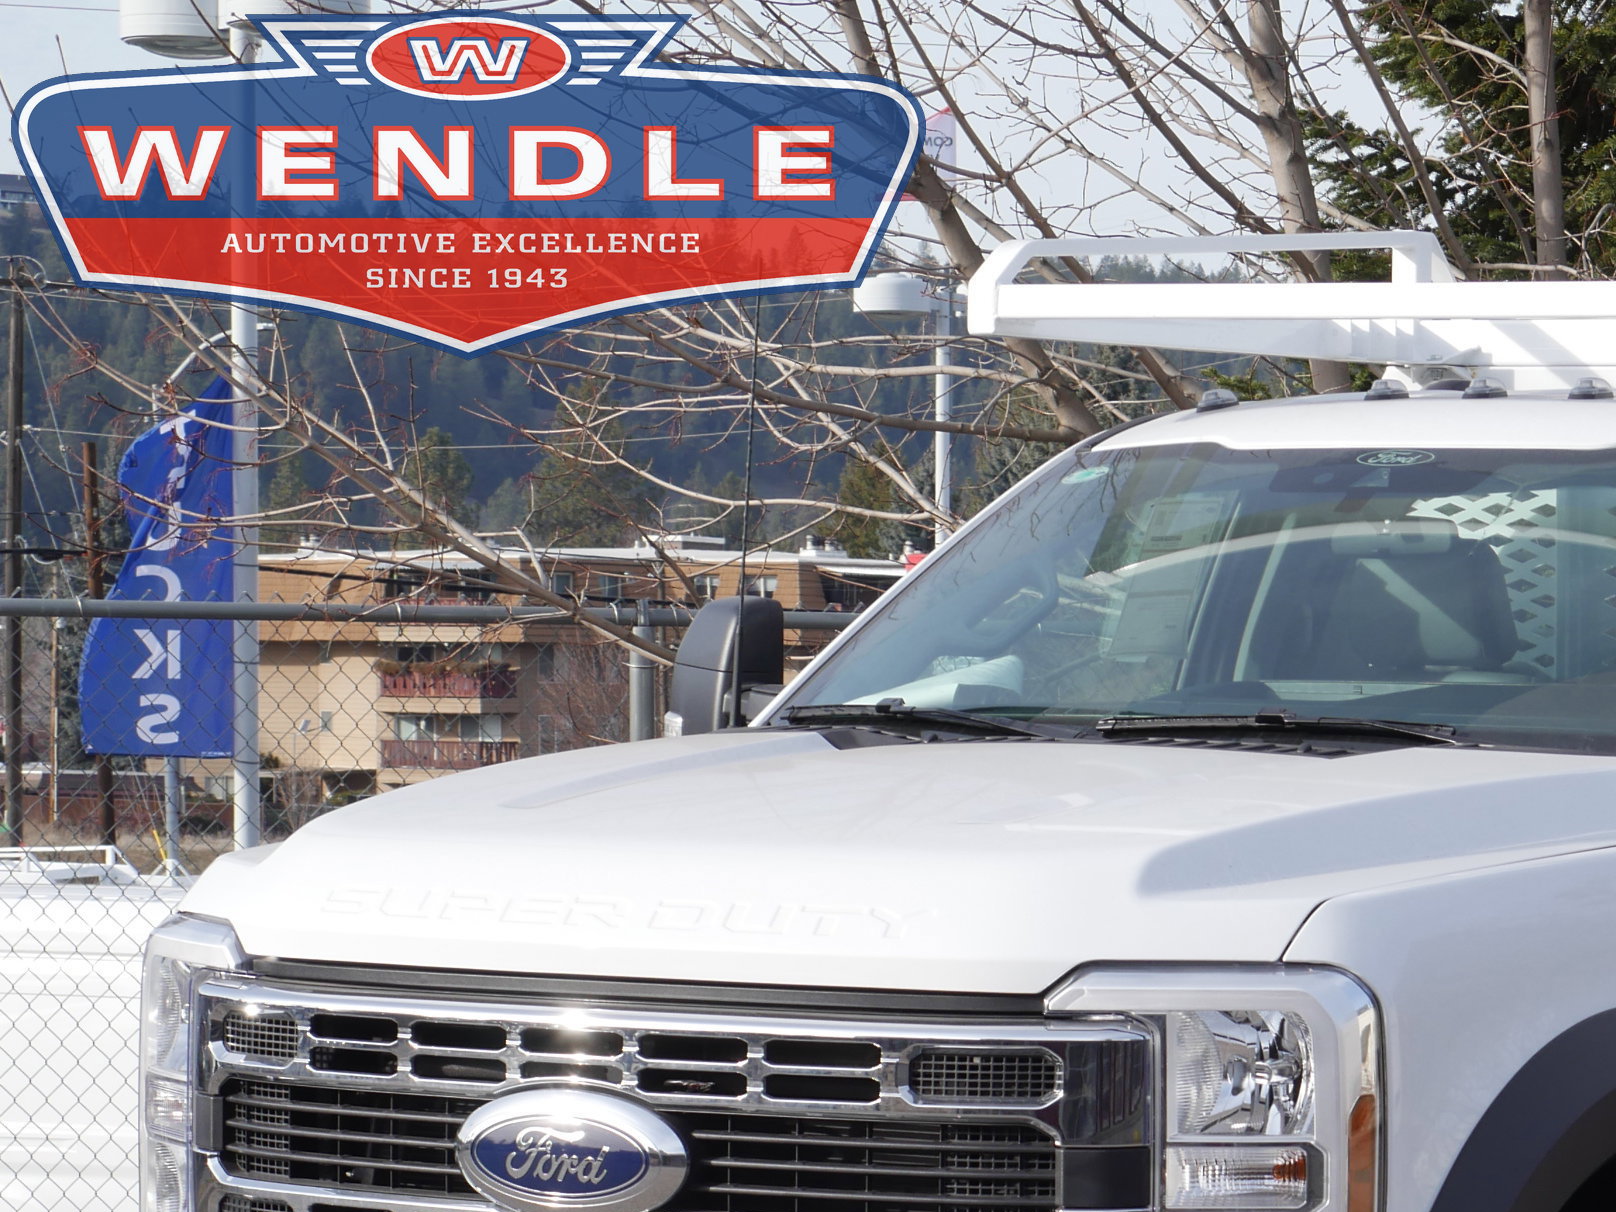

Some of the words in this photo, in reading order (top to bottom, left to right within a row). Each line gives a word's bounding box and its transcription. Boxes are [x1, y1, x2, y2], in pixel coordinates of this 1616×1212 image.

[1367, 451, 1423, 464] Ford
[320, 886, 626, 929] SUPER
[646, 898, 938, 940] DUTY
[505, 1126, 610, 1185] Ford
